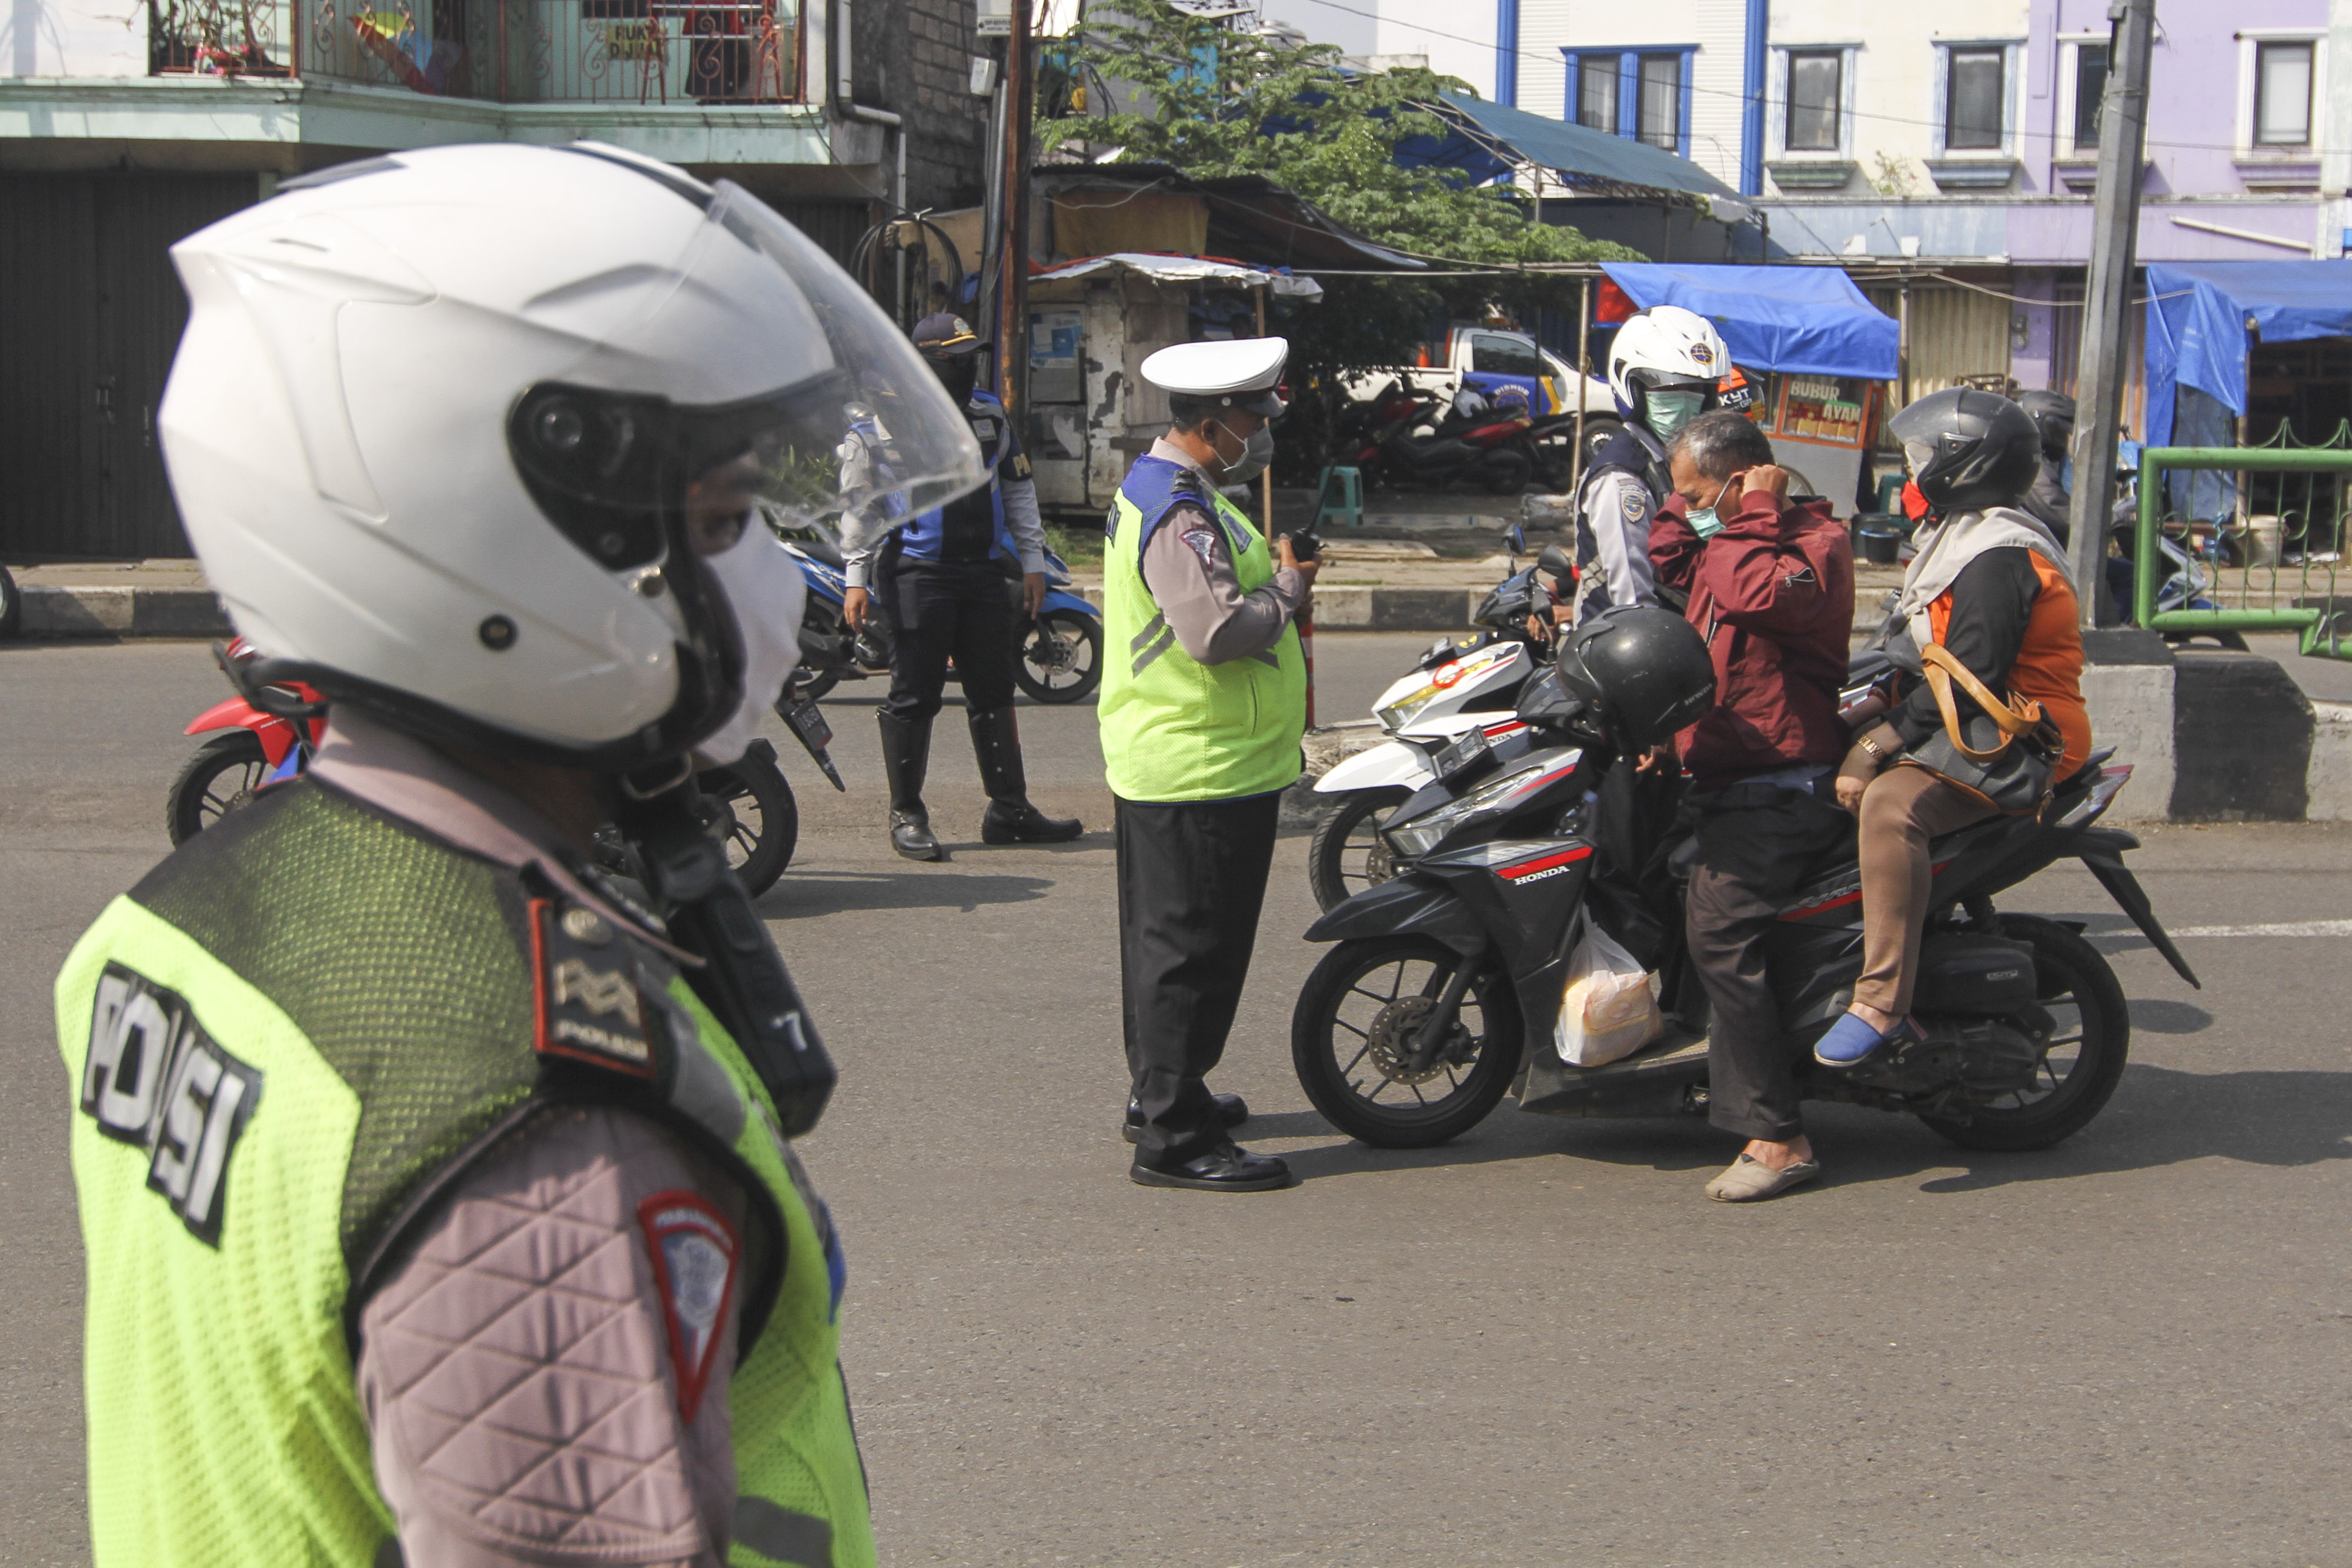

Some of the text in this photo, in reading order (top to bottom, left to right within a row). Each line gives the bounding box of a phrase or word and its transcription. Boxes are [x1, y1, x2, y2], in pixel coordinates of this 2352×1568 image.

[1494, 384, 1529, 397] DISHUB
[1718, 388, 1749, 406] KYT
[1790, 382, 1840, 402] BUBUR
[1488, 734, 1514, 743] NDA
[1515, 865, 1570, 886] HONDA
